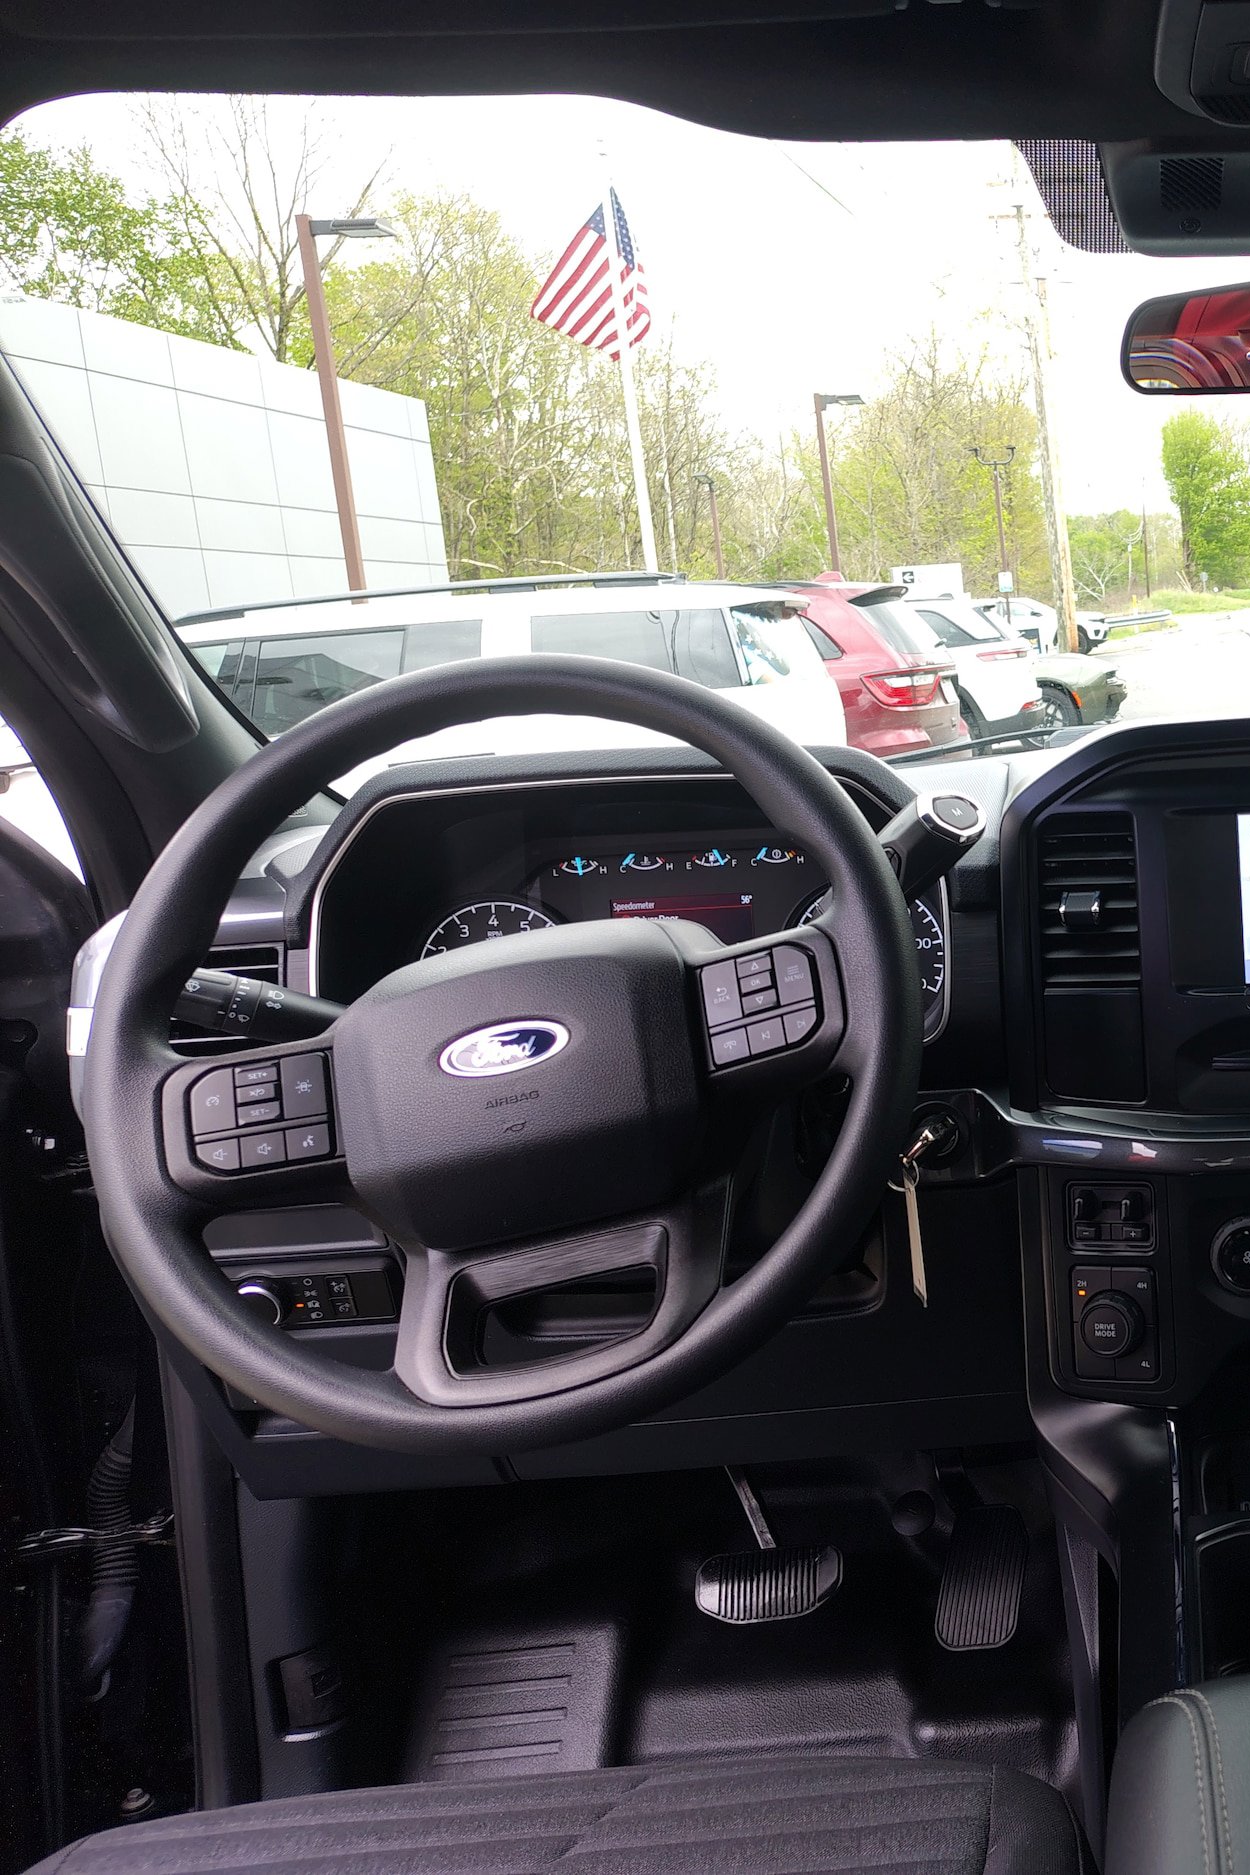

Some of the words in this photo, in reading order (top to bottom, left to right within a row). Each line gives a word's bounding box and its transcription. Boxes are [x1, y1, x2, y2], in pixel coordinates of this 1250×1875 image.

[731, 859, 738, 867] F
[750, 858, 758, 866] C
[796, 856, 804, 864] H
[599, 866, 607, 874] H
[619, 865, 627, 873] C
[666, 863, 674, 871] H
[552, 868, 559, 876] L
[612, 901, 655, 911] Speedometer
[488, 915, 499, 927] 4
[460, 925, 469, 937] 3
[520, 921, 530, 933] 5
[915, 937, 931, 949] 00
[784, 973, 805, 983] MENU
[713, 995, 730, 1004] BACK
[248, 1071, 268, 1080] SET+
[484, 1090, 540, 1109] AIRBAG
[1094, 1323, 1116, 1331] DRIVE
[1140, 1360, 1150, 1368] 4L
